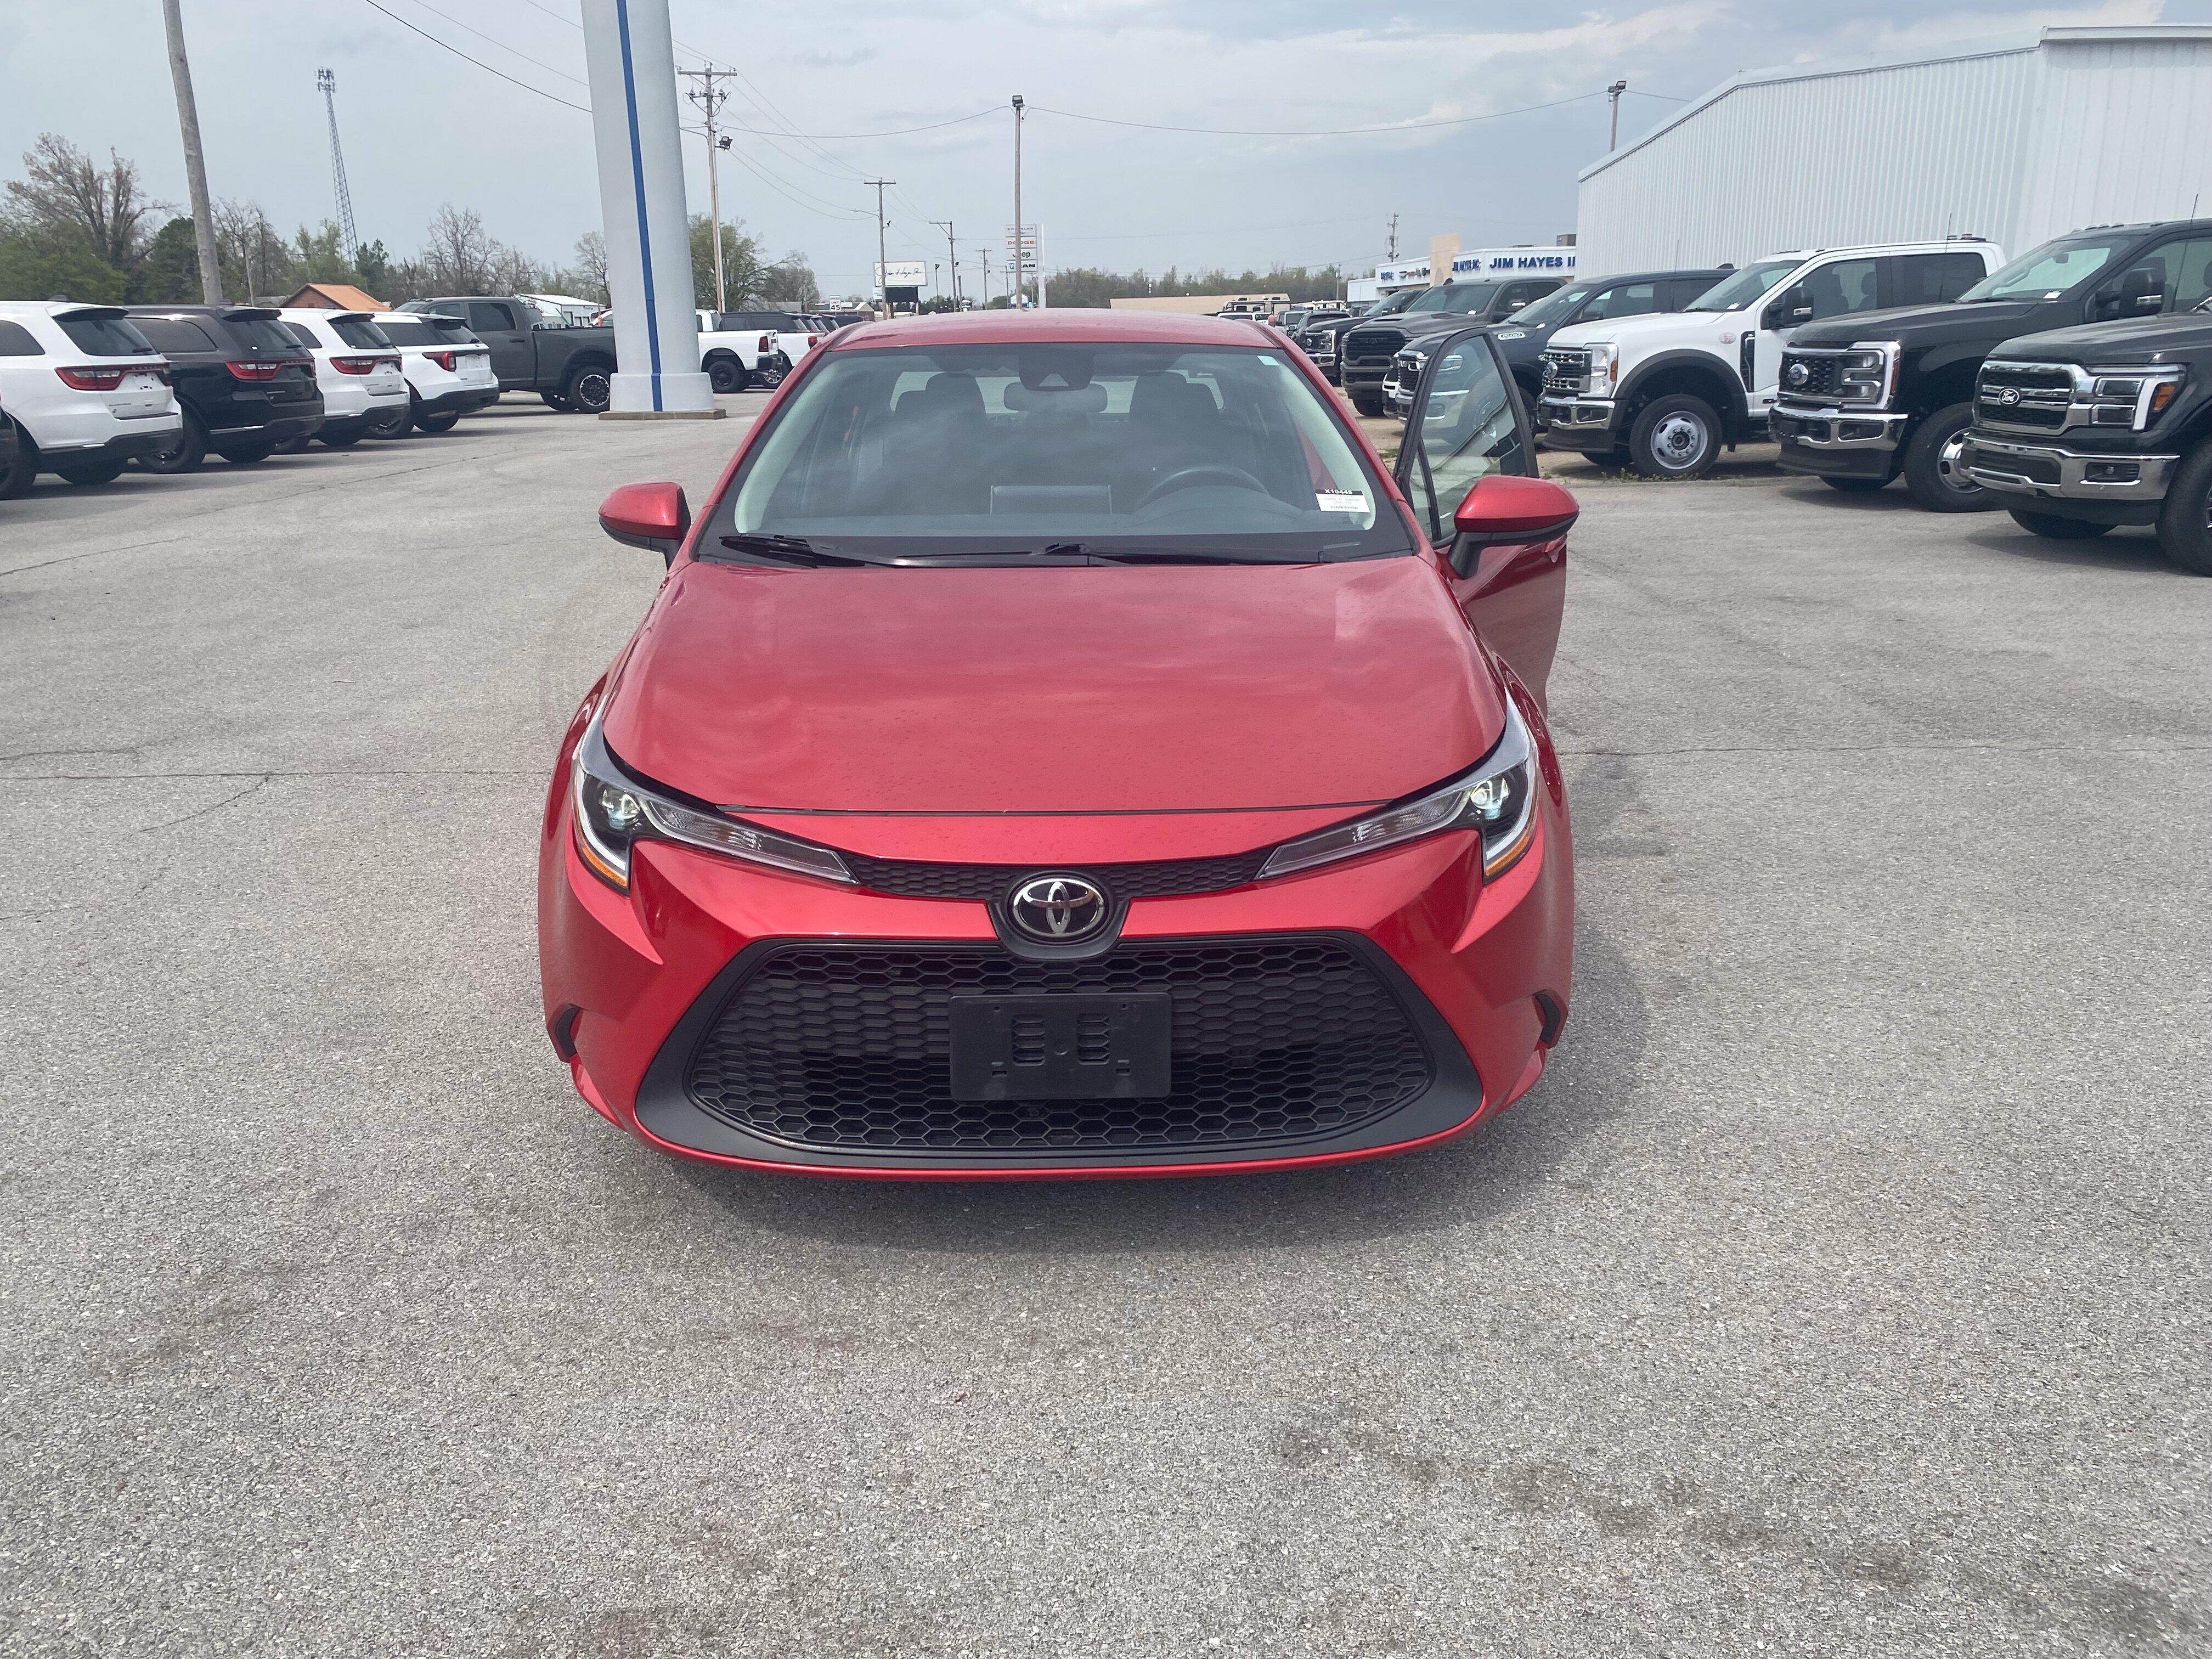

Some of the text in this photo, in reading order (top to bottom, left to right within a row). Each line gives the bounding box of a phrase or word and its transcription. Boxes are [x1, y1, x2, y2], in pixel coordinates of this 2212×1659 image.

[1489, 258, 1514, 268] JIM
[1518, 256, 1563, 268] HAYES
[2002, 391, 2016, 402] Ford
